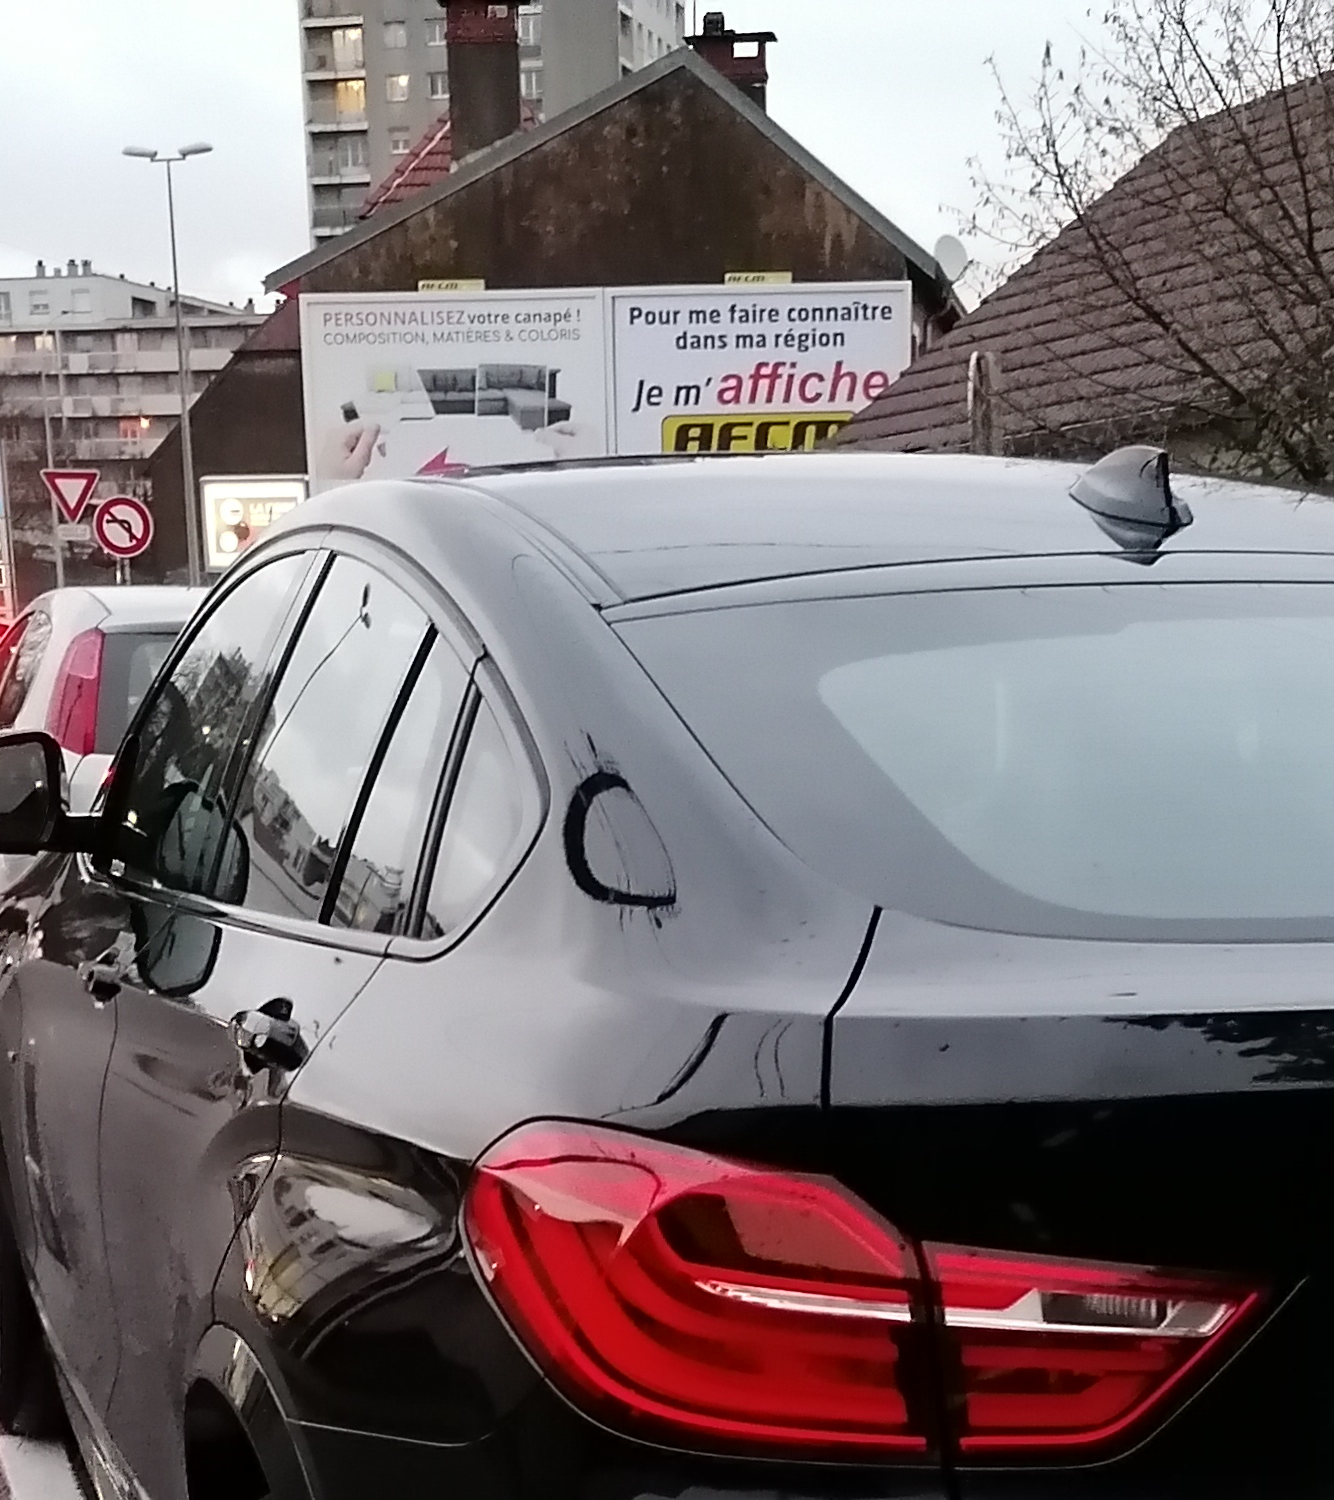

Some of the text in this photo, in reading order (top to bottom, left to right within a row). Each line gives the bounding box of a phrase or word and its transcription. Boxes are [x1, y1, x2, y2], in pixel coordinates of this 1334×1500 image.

[323, 310, 465, 327] PERSONNALISEZ
[467, 311, 510, 325] votre
[515, 307, 572, 326] canapé
[629, 301, 893, 325] Pour me faire connaître
[323, 327, 581, 345] COMPOSITION, MATIÈRES & COLORIS
[676, 329, 845, 352] dans ma région
[631, 379, 663, 412] Je
